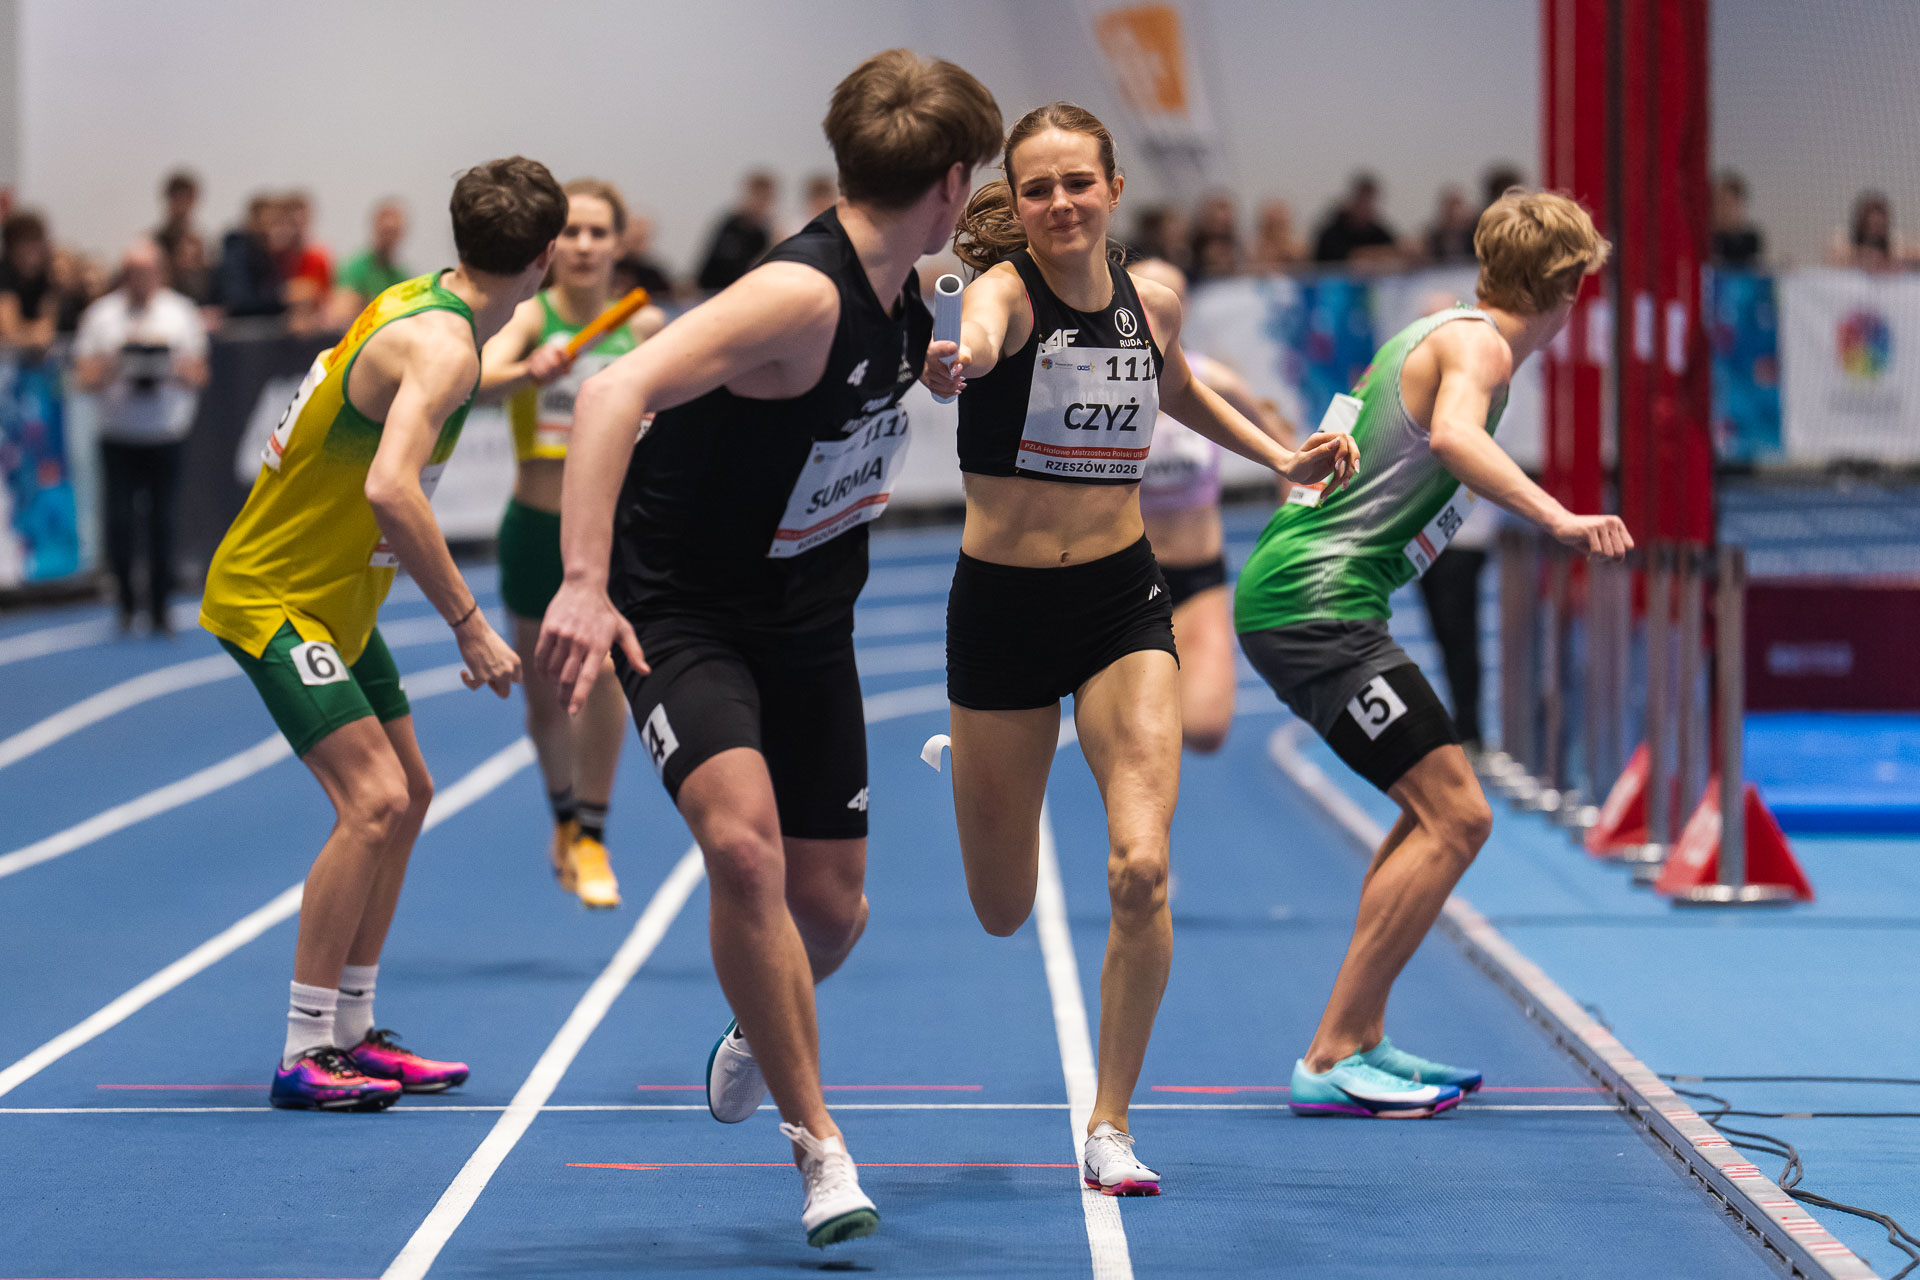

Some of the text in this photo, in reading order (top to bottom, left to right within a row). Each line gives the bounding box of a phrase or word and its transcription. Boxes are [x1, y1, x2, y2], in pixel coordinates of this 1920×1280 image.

[1119, 338, 1143, 348] RUDA
[1063, 396, 1140, 432] CZYŻ
[1045, 459, 1107, 474] RZESZÓW
[1108, 463, 1138, 475] 2026
[805, 456, 884, 515] SURMA
[305, 644, 337, 679] 6
[1356, 682, 1391, 726] 5
[648, 719, 665, 766] 4
